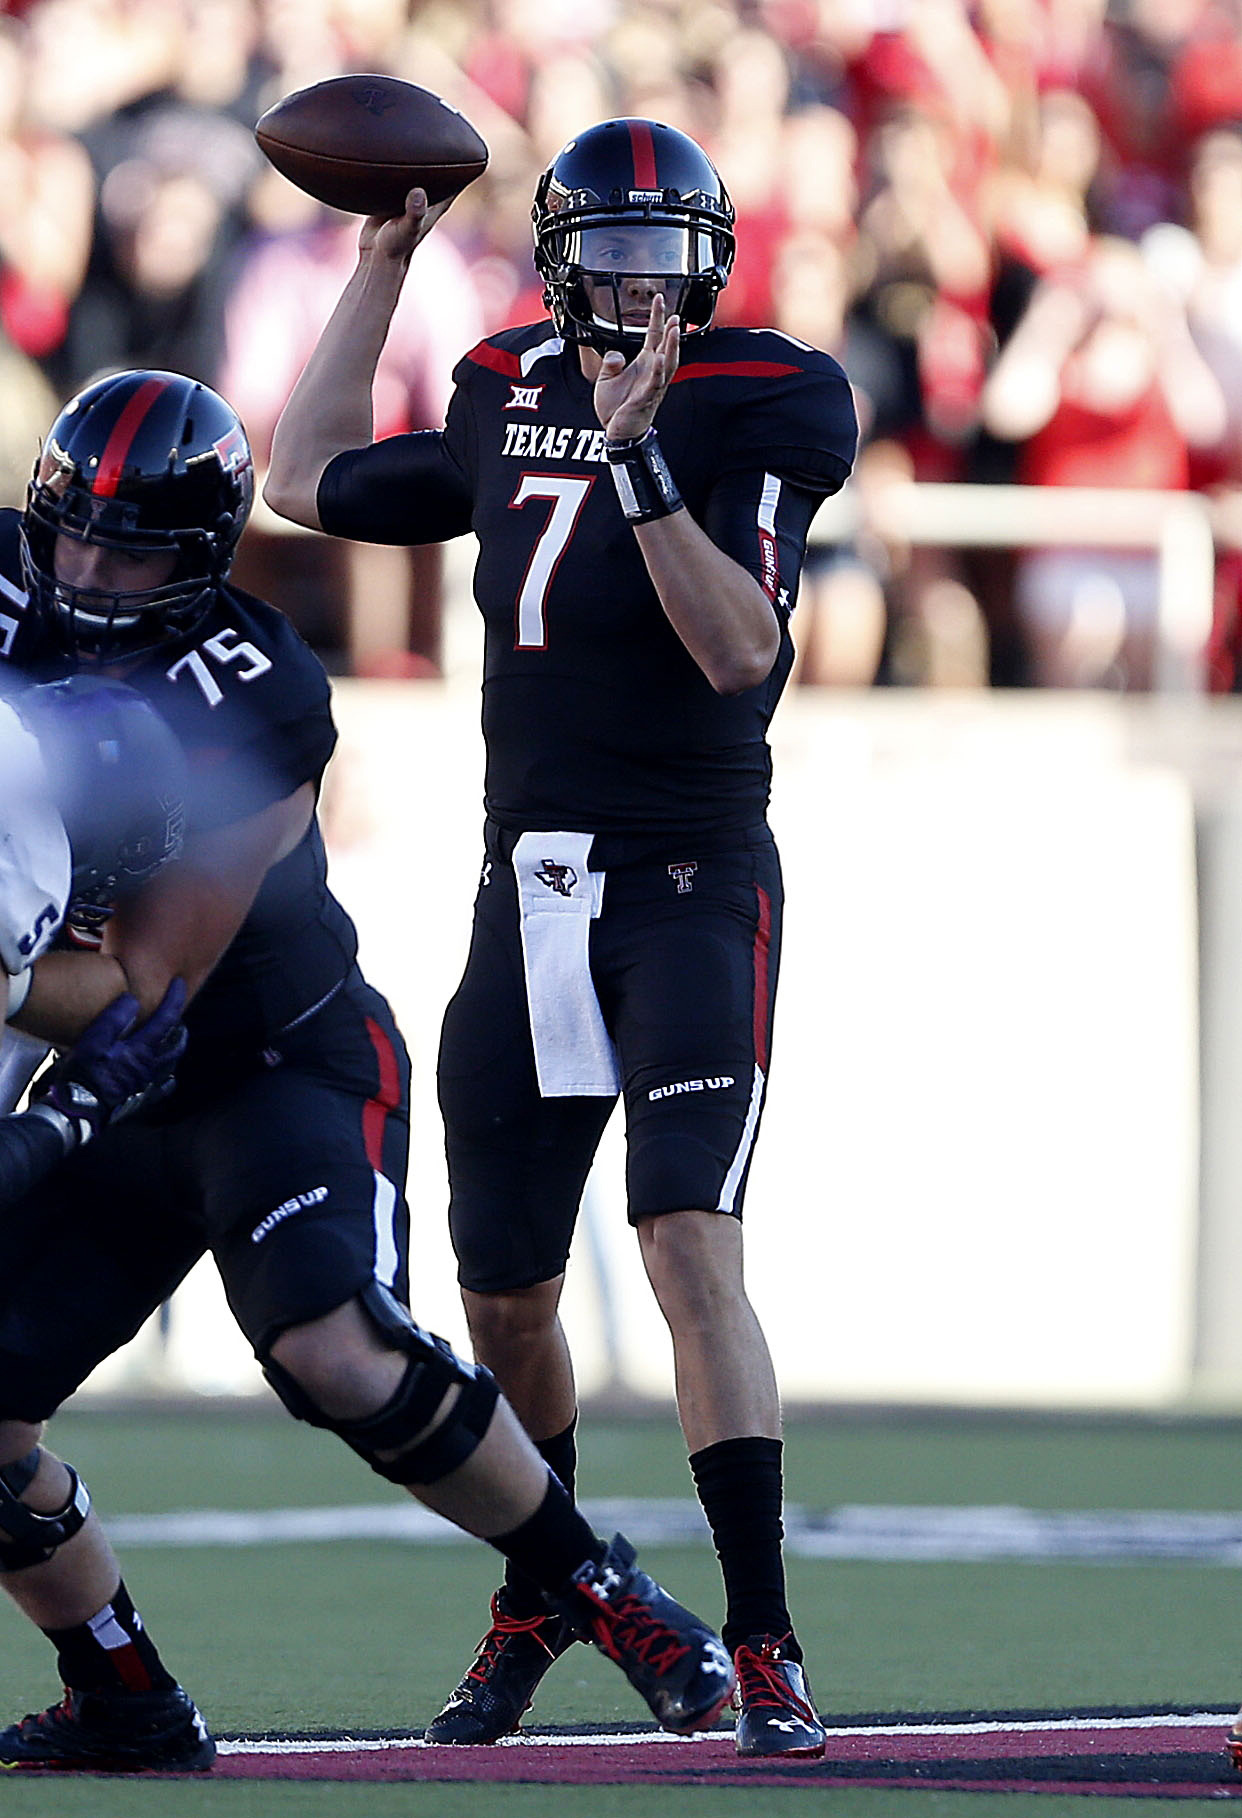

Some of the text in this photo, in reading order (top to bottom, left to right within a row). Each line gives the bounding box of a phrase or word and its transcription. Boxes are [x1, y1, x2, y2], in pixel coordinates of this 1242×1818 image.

[504, 384, 545, 410] XII
[501, 423, 573, 459] TEXAS
[508, 471, 597, 650] 7
[165, 627, 273, 707] 75
[648, 1076, 735, 1102] GUNS UP
[251, 1186, 328, 1243] GUNS UP
